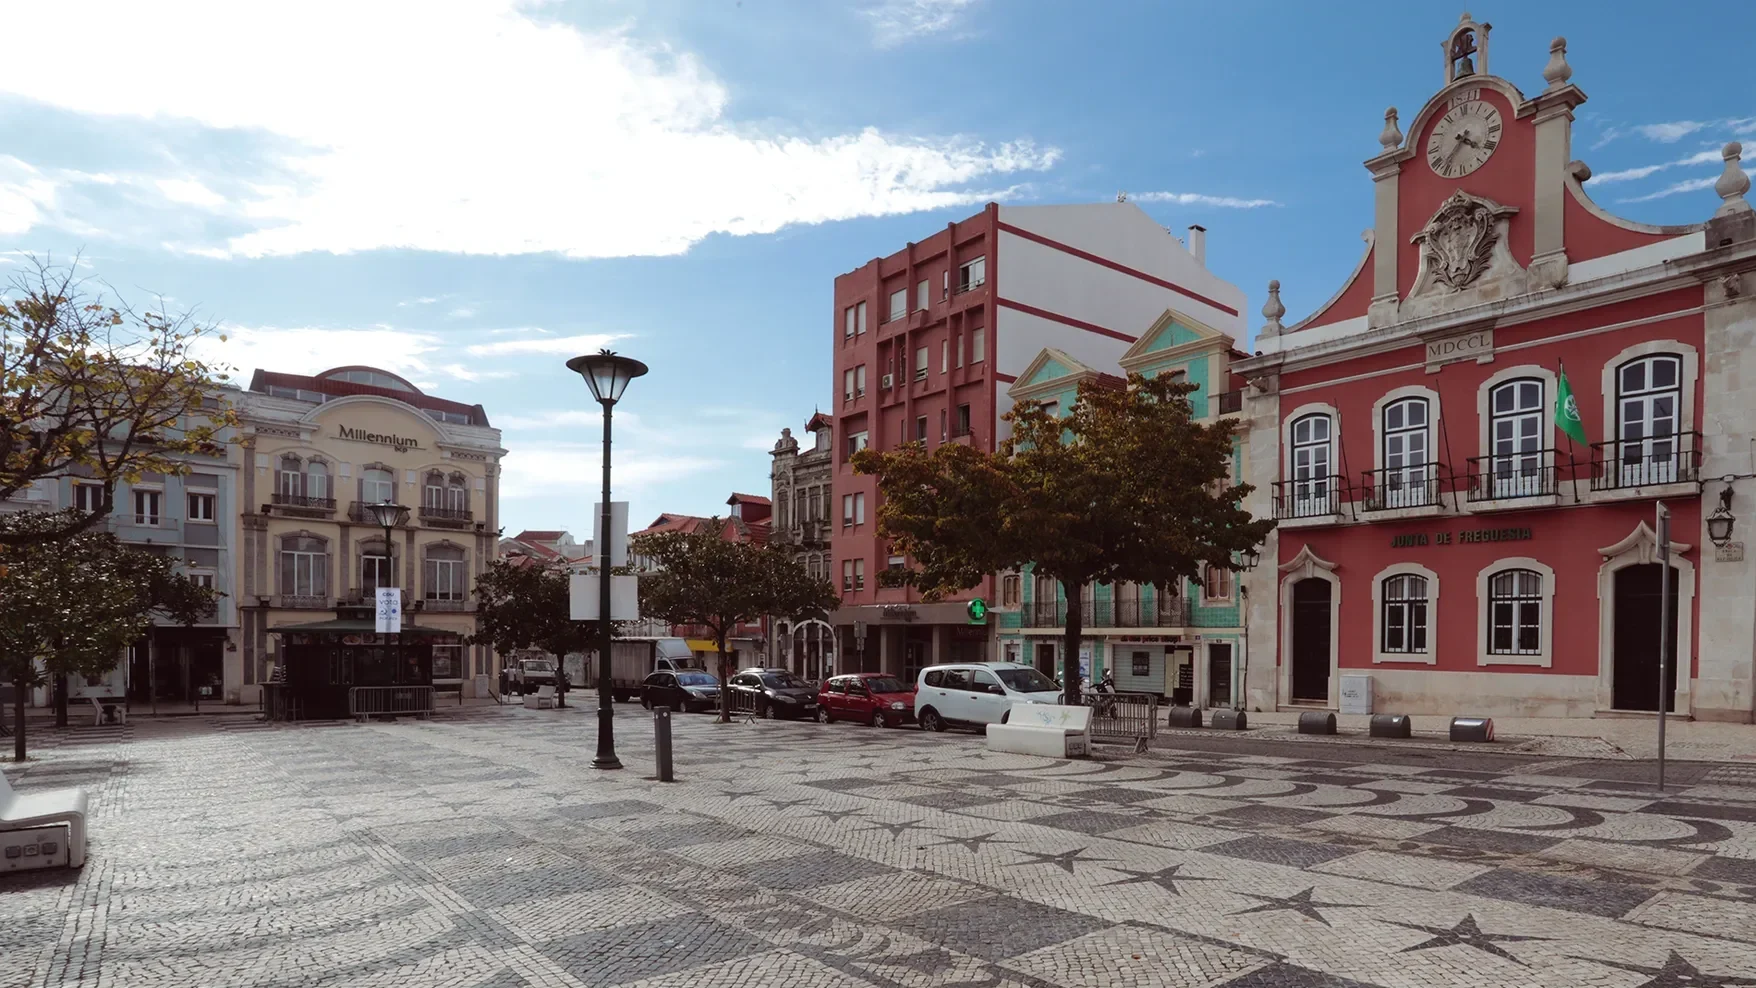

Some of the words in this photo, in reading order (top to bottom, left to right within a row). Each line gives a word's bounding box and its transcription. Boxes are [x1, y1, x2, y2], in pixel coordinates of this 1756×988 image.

[1429, 334, 1490, 357] MDCCL
[339, 424, 418, 447] Millennium
[1391, 533, 1429, 548] JUNTA
[1435, 532, 1451, 545] DE
[1458, 528, 1531, 543] FREGUESIA
